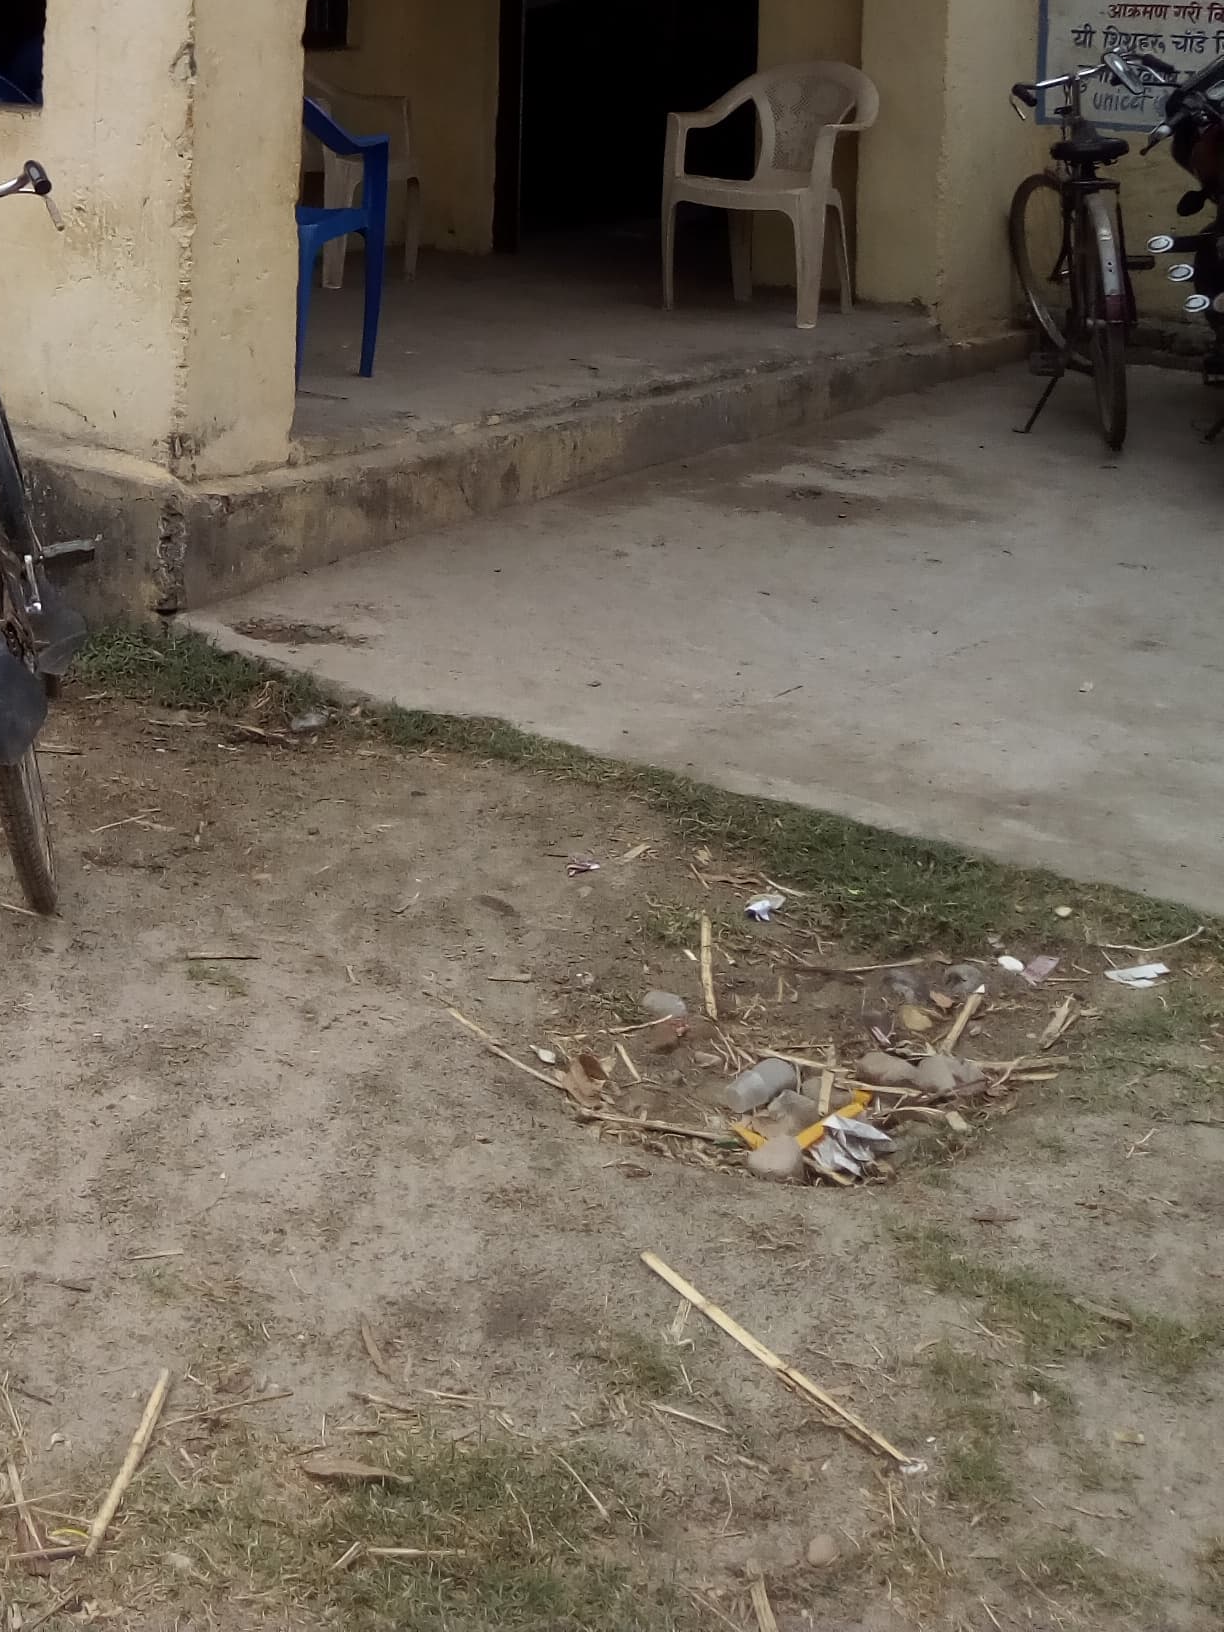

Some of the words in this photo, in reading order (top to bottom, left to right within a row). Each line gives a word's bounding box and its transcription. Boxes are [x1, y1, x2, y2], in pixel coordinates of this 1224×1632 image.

[1107, 4, 1171, 20] आक्रमण
[1173, 1, 1203, 24] गरी
[1071, 23, 1096, 48] यी
